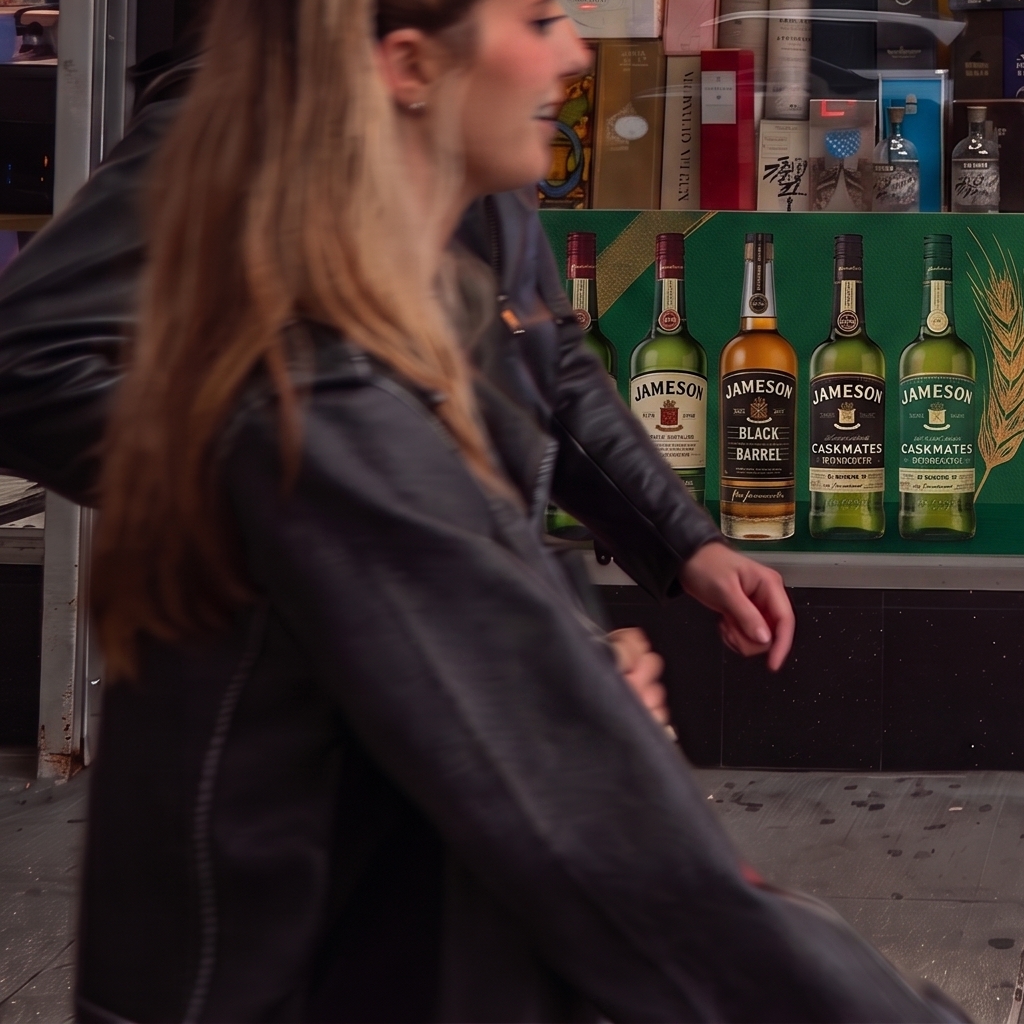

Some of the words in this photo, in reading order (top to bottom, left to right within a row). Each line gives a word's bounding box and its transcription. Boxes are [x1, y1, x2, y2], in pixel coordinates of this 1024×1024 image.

[634, 380, 704, 401] JAMESON
[725, 379, 793, 400] JAMESON
[812, 384, 883, 405] JAMESON
[901, 384, 973, 405] JAMESON
[739, 427, 779, 440] BLACK
[736, 448, 782, 461] BARREL
[811, 443, 883, 454] CASKMATES
[901, 443, 973, 455] CASKMATES
